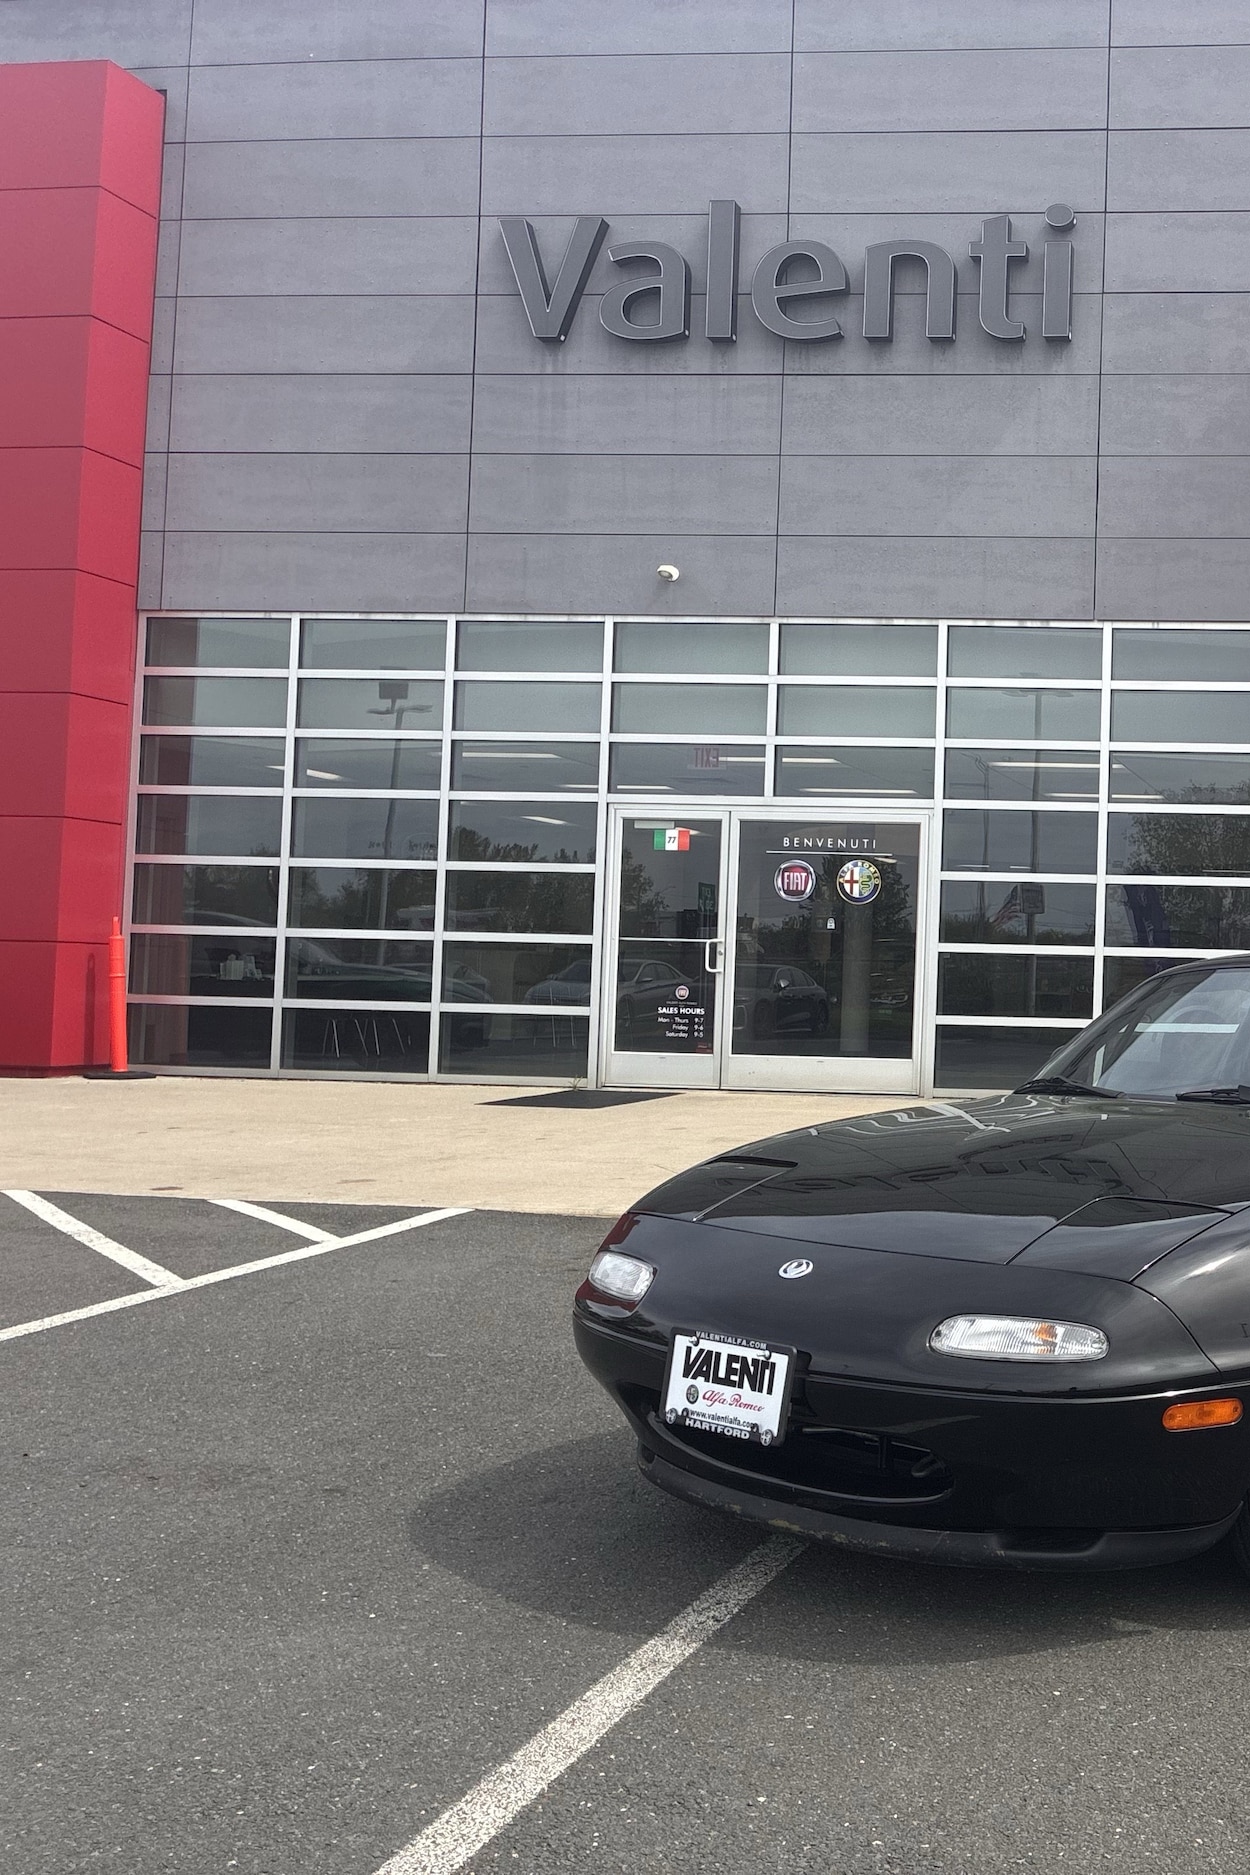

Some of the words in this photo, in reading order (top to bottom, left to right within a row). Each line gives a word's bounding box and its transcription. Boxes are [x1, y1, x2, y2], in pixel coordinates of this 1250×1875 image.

[497, 199, 1078, 343] Valenti
[666, 835, 677, 845] 77
[783, 836, 876, 849] BENVENUTI
[783, 872, 807, 891] FIAT
[857, 861, 880, 885] ROMEO
[657, 1006, 678, 1014] SALES
[680, 1007, 705, 1015] HOURS
[665, 1031, 688, 1039] Saturday
[696, 1331, 767, 1350] VALENTIALFA.COM
[682, 1346, 776, 1396] VALENTI
[702, 1389, 729, 1408] Alfa
[728, 1393, 765, 1412] Romeo
[685, 1418, 750, 1440] HARTFORD
